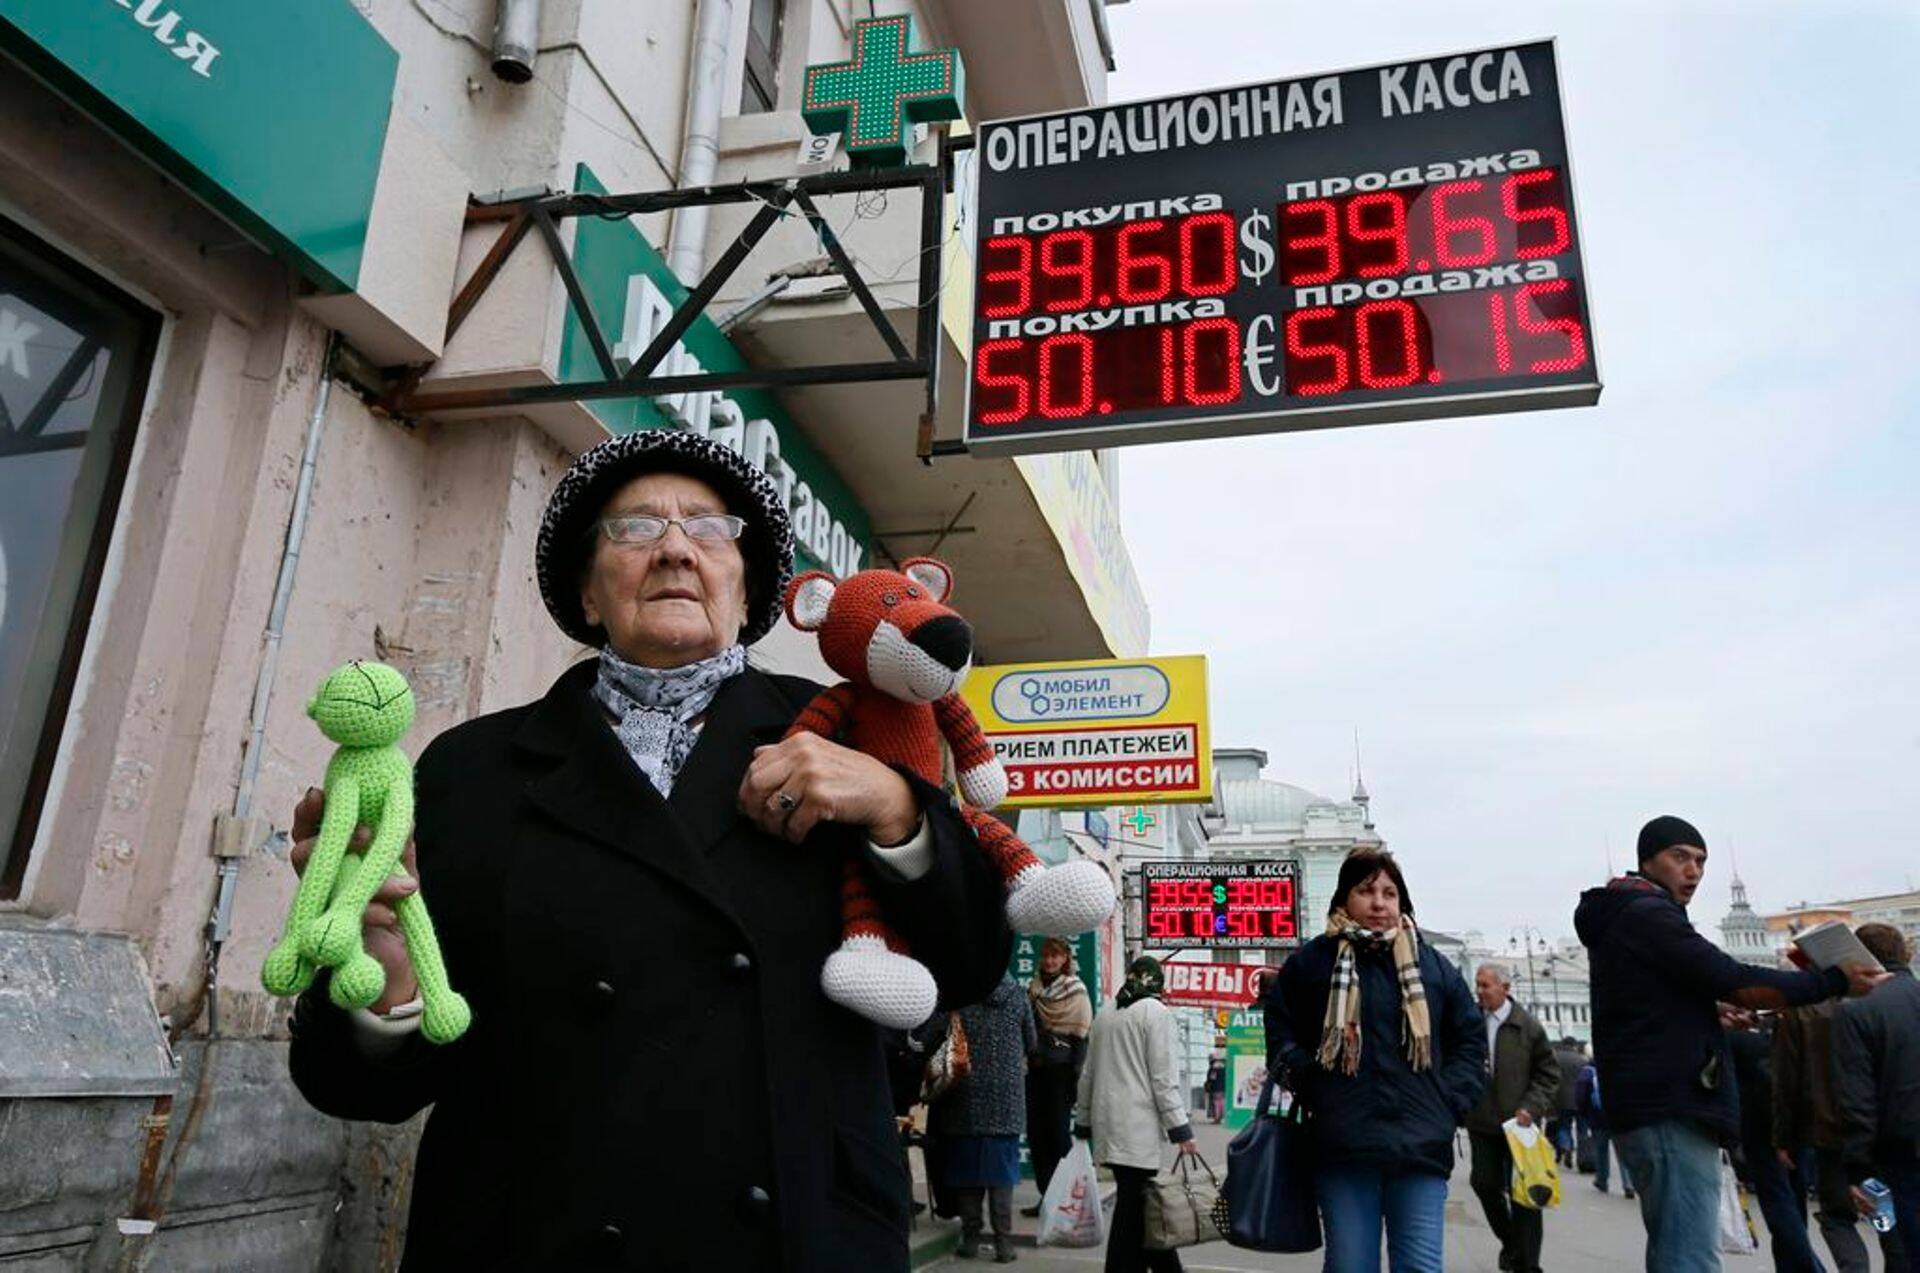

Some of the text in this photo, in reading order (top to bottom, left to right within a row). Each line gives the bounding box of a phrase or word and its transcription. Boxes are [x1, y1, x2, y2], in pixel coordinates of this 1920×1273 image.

[986, 50, 1531, 172] ОПЕРАЦИОННАЯ КАССА
[985, 169, 1571, 318] 39.60 $ 39.65
[1244, 314, 1280, 396] €
[1044, 678, 1111, 694] МОБИЛ
[1053, 694, 1144, 712] ЭЛЕМЕНТ
[989, 730, 1188, 759] РИЕМ ПЛАТЕЖЕЙ
[1033, 763, 1195, 790] КОМИССИИ
[1146, 864, 1294, 877] ОПЕРАЦИОННАЯ КАССА
[1213, 884, 1227, 904] $
